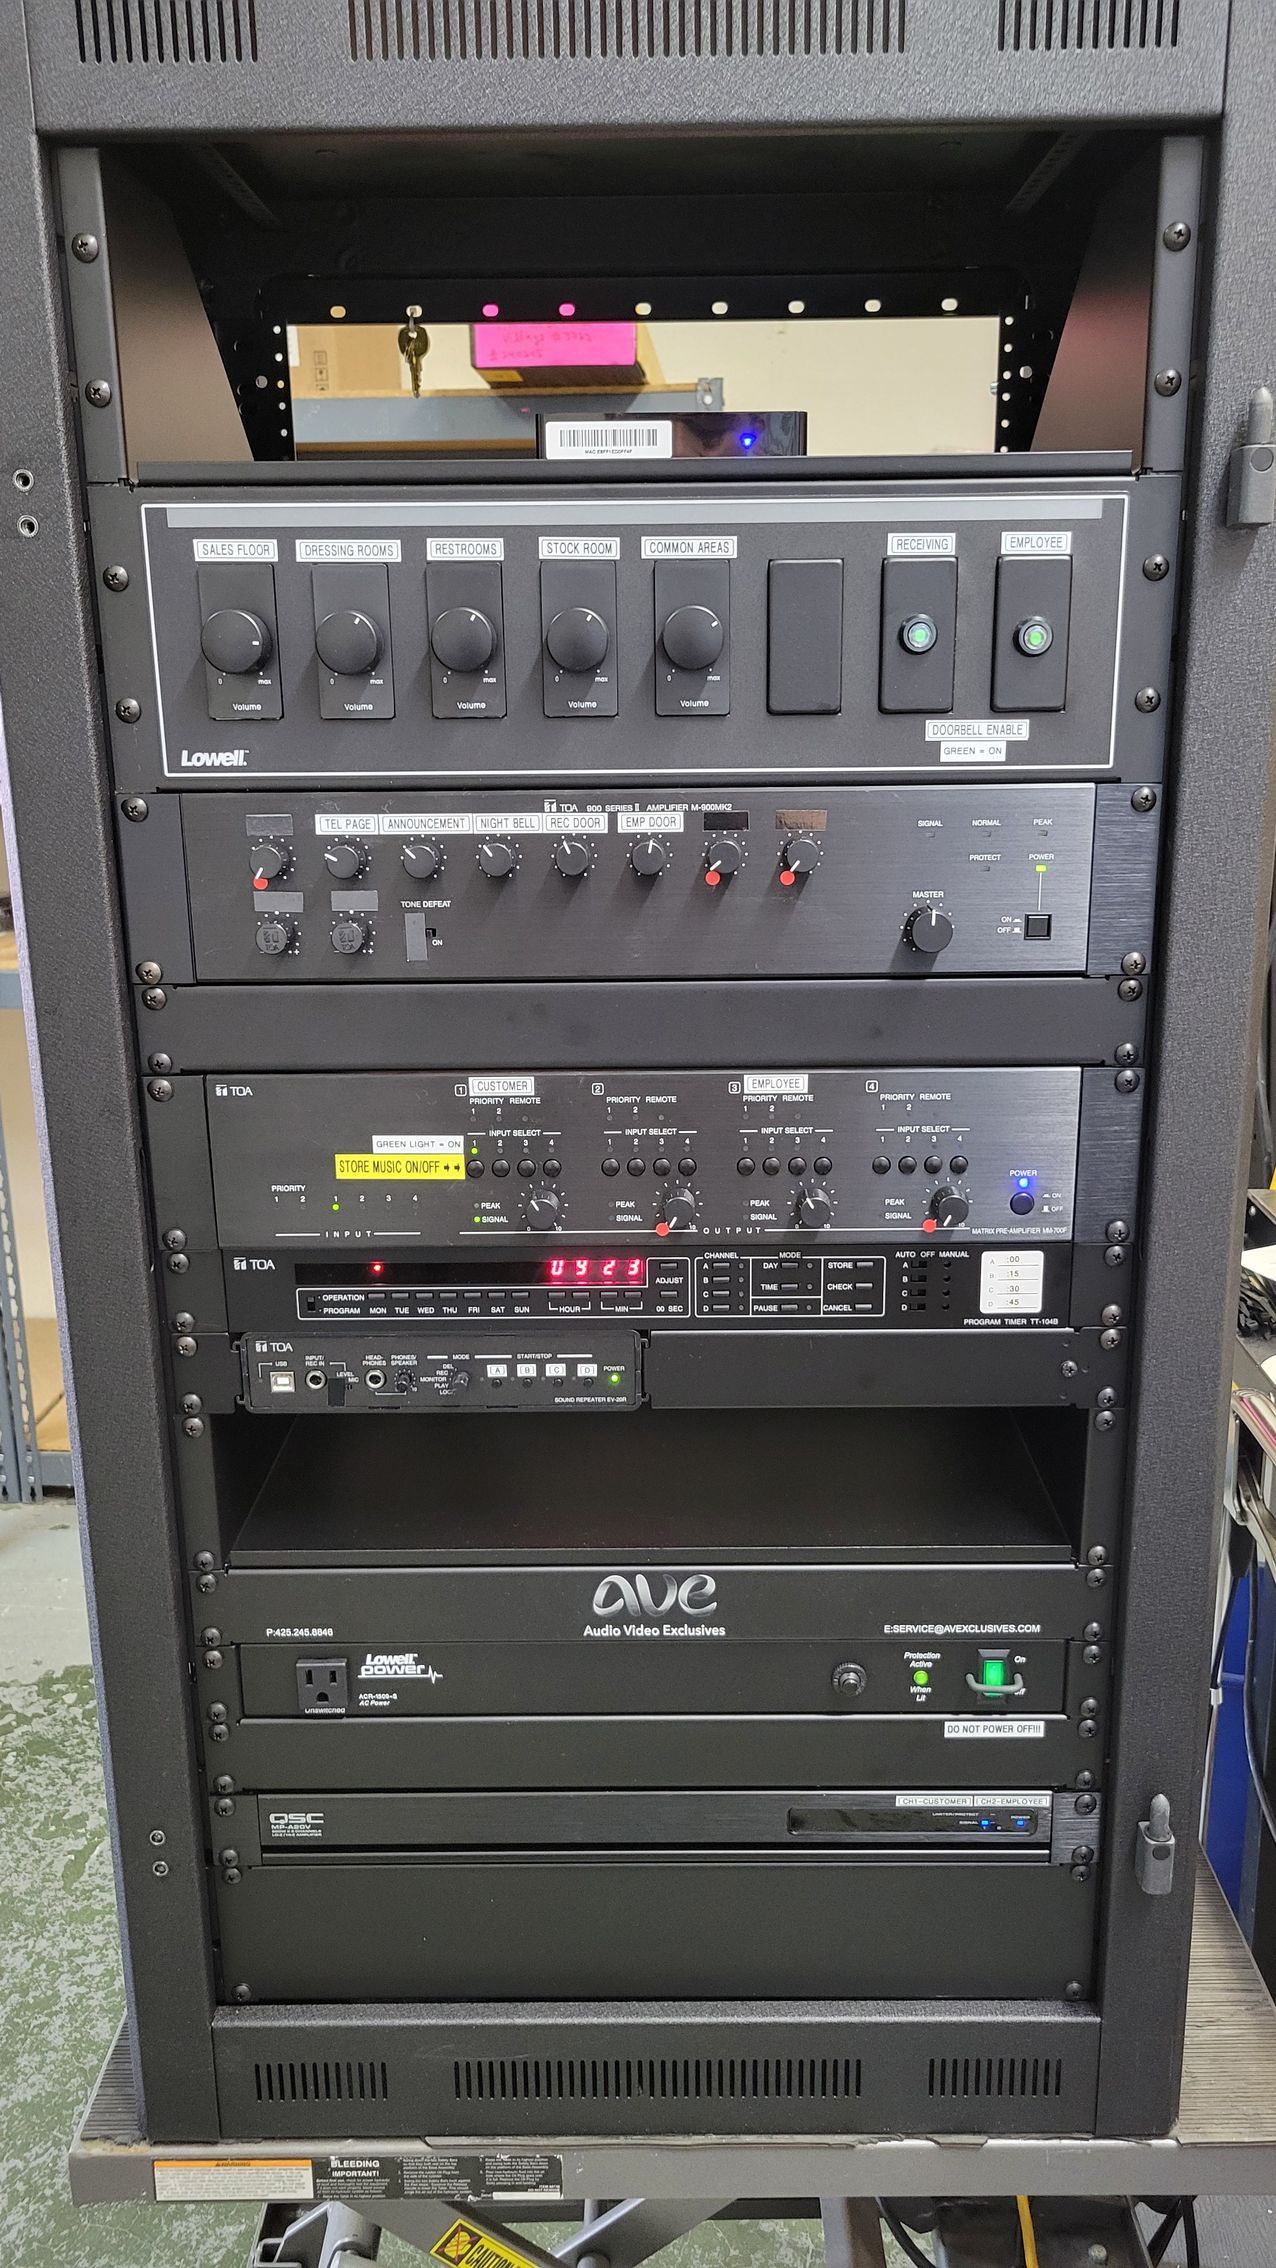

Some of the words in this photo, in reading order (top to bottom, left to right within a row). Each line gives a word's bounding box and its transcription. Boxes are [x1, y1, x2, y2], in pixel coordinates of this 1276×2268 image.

[650, 540, 693, 554] COMMON
[697, 539, 729, 553] AREAS
[896, 537, 949, 551] RECEIVING
[1010, 535, 1063, 549] EMPLOYEE
[202, 543, 233, 556] SALES
[237, 542, 270, 556] FLOOR
[304, 544, 353, 558] DRESSING
[357, 544, 394, 558] ROOMS
[435, 542, 497, 556] RESTROOMS
[546, 542, 578, 555] STOCK
[581, 541, 612, 555] ROOM
[232, 703, 262, 711] Volume
[344, 703, 373, 711] Volume
[456, 701, 486, 709] Volume
[568, 700, 597, 708] Volume
[680, 699, 709, 707] Volume
[932, 723, 982, 736] DOORBELL
[985, 723, 1023, 736] ENABLE
[944, 746, 975, 756] GREEN
[988, 746, 1002, 755] ON
[559, 804, 578, 812] TOA
[605, 804, 633, 812] SERIES
[324, 818, 342, 830] TEL
[345, 818, 371, 830] PAGE
[387, 818, 465, 830] ANNOUNCEMENT
[480, 817, 509, 829] NIGHT
[513, 817, 535, 828] BELL
[551, 818, 569, 828] REC
[574, 817, 600, 828] DOOR
[626, 819, 645, 827] EMP
[650, 817, 676, 827] DOOR
[1033, 818, 1052, 826] PEAK
[969, 854, 1001, 862] PROTECT
[912, 891, 944, 899] MASTER
[422, 900, 451, 908] DEFEAT
[478, 1081, 528, 1091] CUSTOMER
[752, 1079, 800, 1088] EMPLOYEE
[230, 1086, 253, 1097] TOA
[409, 1140, 437, 1148] LIGHT
[448, 1140, 461, 1148] ON
[339, 1161, 370, 1173] STORE
[373, 1160, 402, 1173] MUSIC
[405, 1159, 440, 1173] ON/OFF
[250, 1259, 275, 1270] TOA
[270, 1343, 293, 1352] TOA
[584, 1624, 621, 1637] Audio
[623, 1624, 660, 1636] Video
[663, 1624, 726, 1636] Exclusives
[884, 1624, 1041, 1634] E:SERVICE@AVEXCLUSIVES.COM
[366, 1653, 417, 1665] Lowell
[904, 1651, 941, 1660] Protection
[1014, 1655, 1026, 1663] On
[910, 1660, 933, 1668] Active
[360, 1664, 425, 1676] power
[910, 1686, 932, 1694] When
[947, 1724, 960, 1734] DO
[962, 1724, 981, 1734] NOT
[983, 1724, 1014, 1734] POWER
[1016, 1724, 1041, 1734] OFF!!!
[269, 1813, 324, 1824] QSC
[331, 2159, 380, 2169] BLEEDING
[332, 2169, 380, 2177] IMPORTANT!
